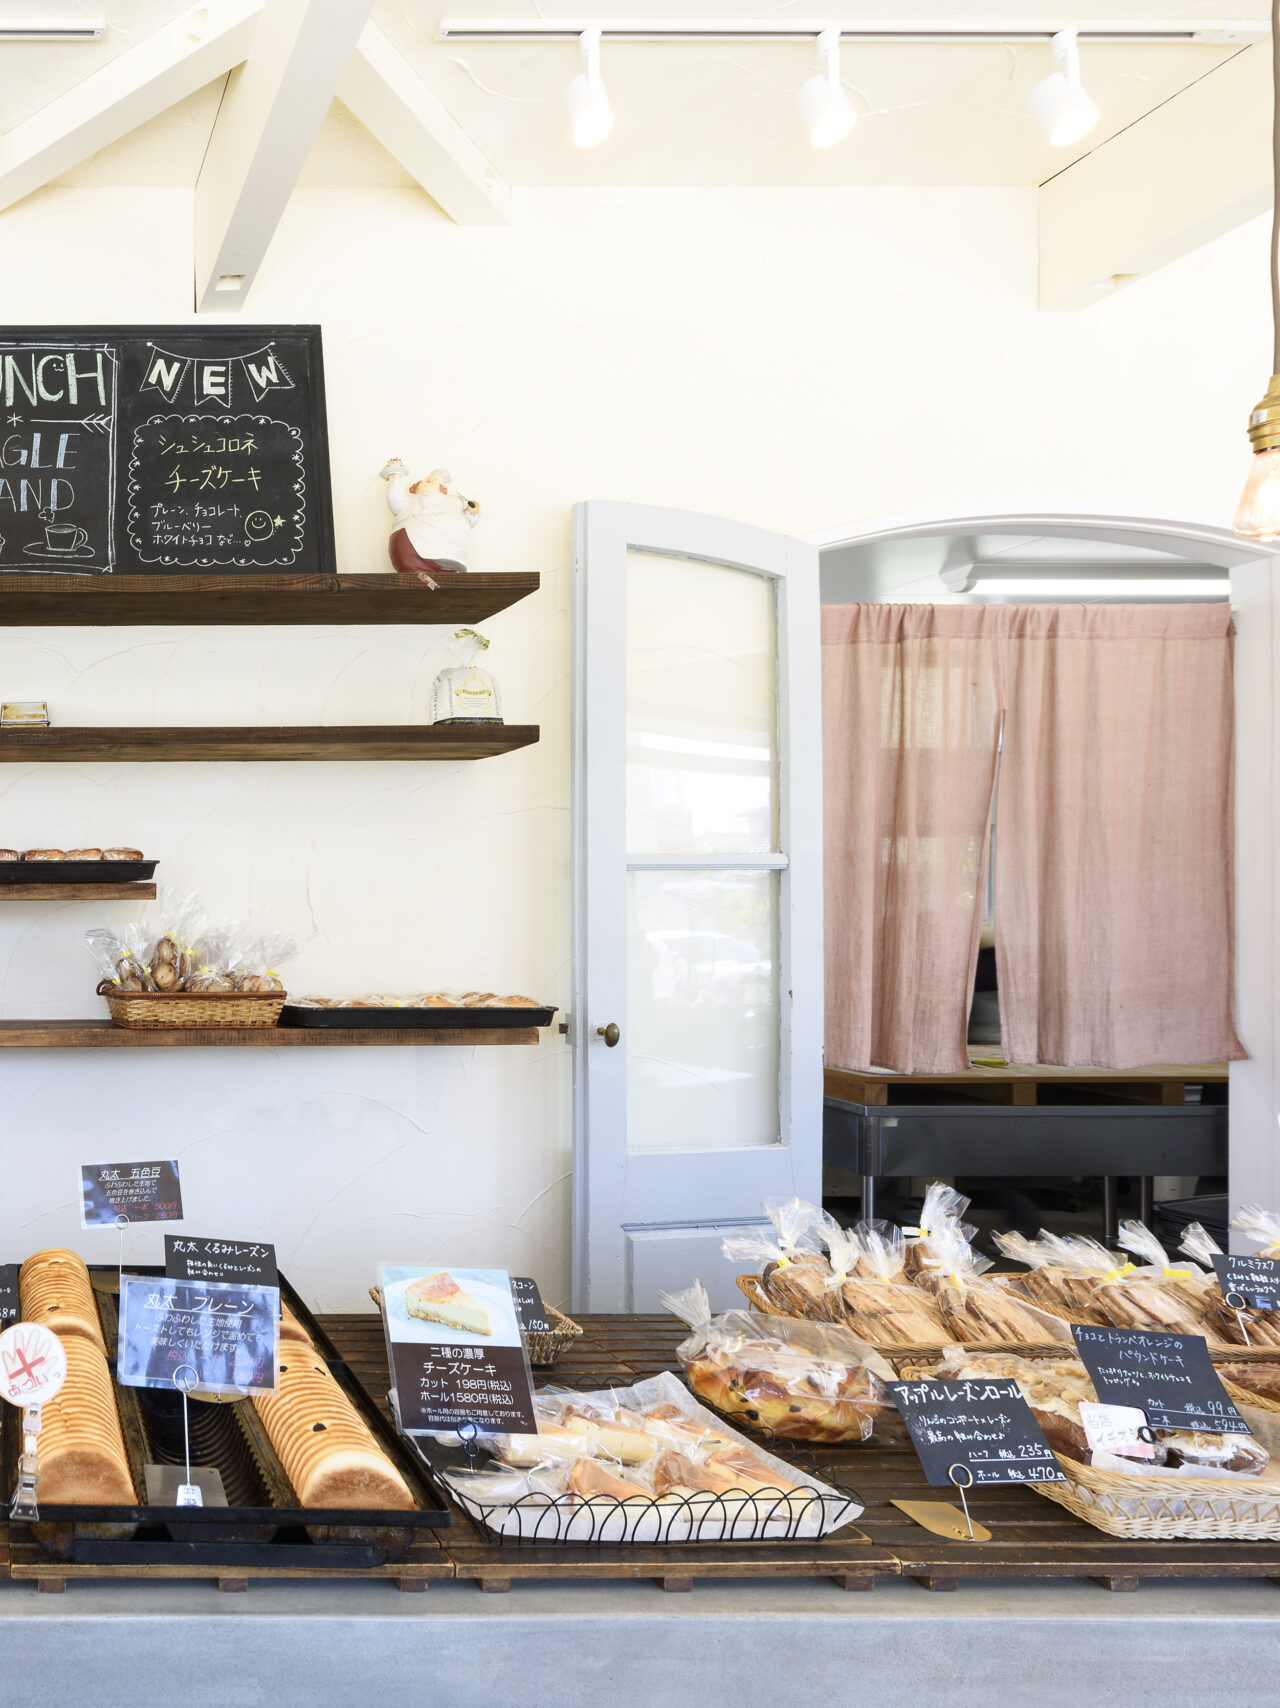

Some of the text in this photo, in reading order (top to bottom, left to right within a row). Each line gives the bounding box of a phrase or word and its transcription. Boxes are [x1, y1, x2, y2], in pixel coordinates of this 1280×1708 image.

[148, 356, 280, 395] NEW
[158, 432, 258, 455] シュシュコロネ
[165, 464, 262, 493] チーズケーキ
[151, 521, 212, 532] ブルーベリー
[152, 534, 213, 547] ホワイトチョコ
[99, 1166, 161, 1180] 丸太 五色豆
[173, 1240, 270, 1258] 丸太 くるみレーズン
[144, 1292, 255, 1315] 丸太 プレーン
[430, 1346, 485, 1360] 二種の濃厚
[1119, 1350, 1185, 1368] パウンドケーキ
[423, 1361, 497, 1376] チーズケーキ
[420, 1377, 512, 1391] カット 198円(税込)
[894, 1381, 1023, 1405] アップルレーズンロール
[1207, 1400, 1237, 1416] 99円
[1214, 1419, 1249, 1432] 594円
[1018, 1442, 1053, 1459] 235円
[1028, 1466, 1067, 1481] 470円
